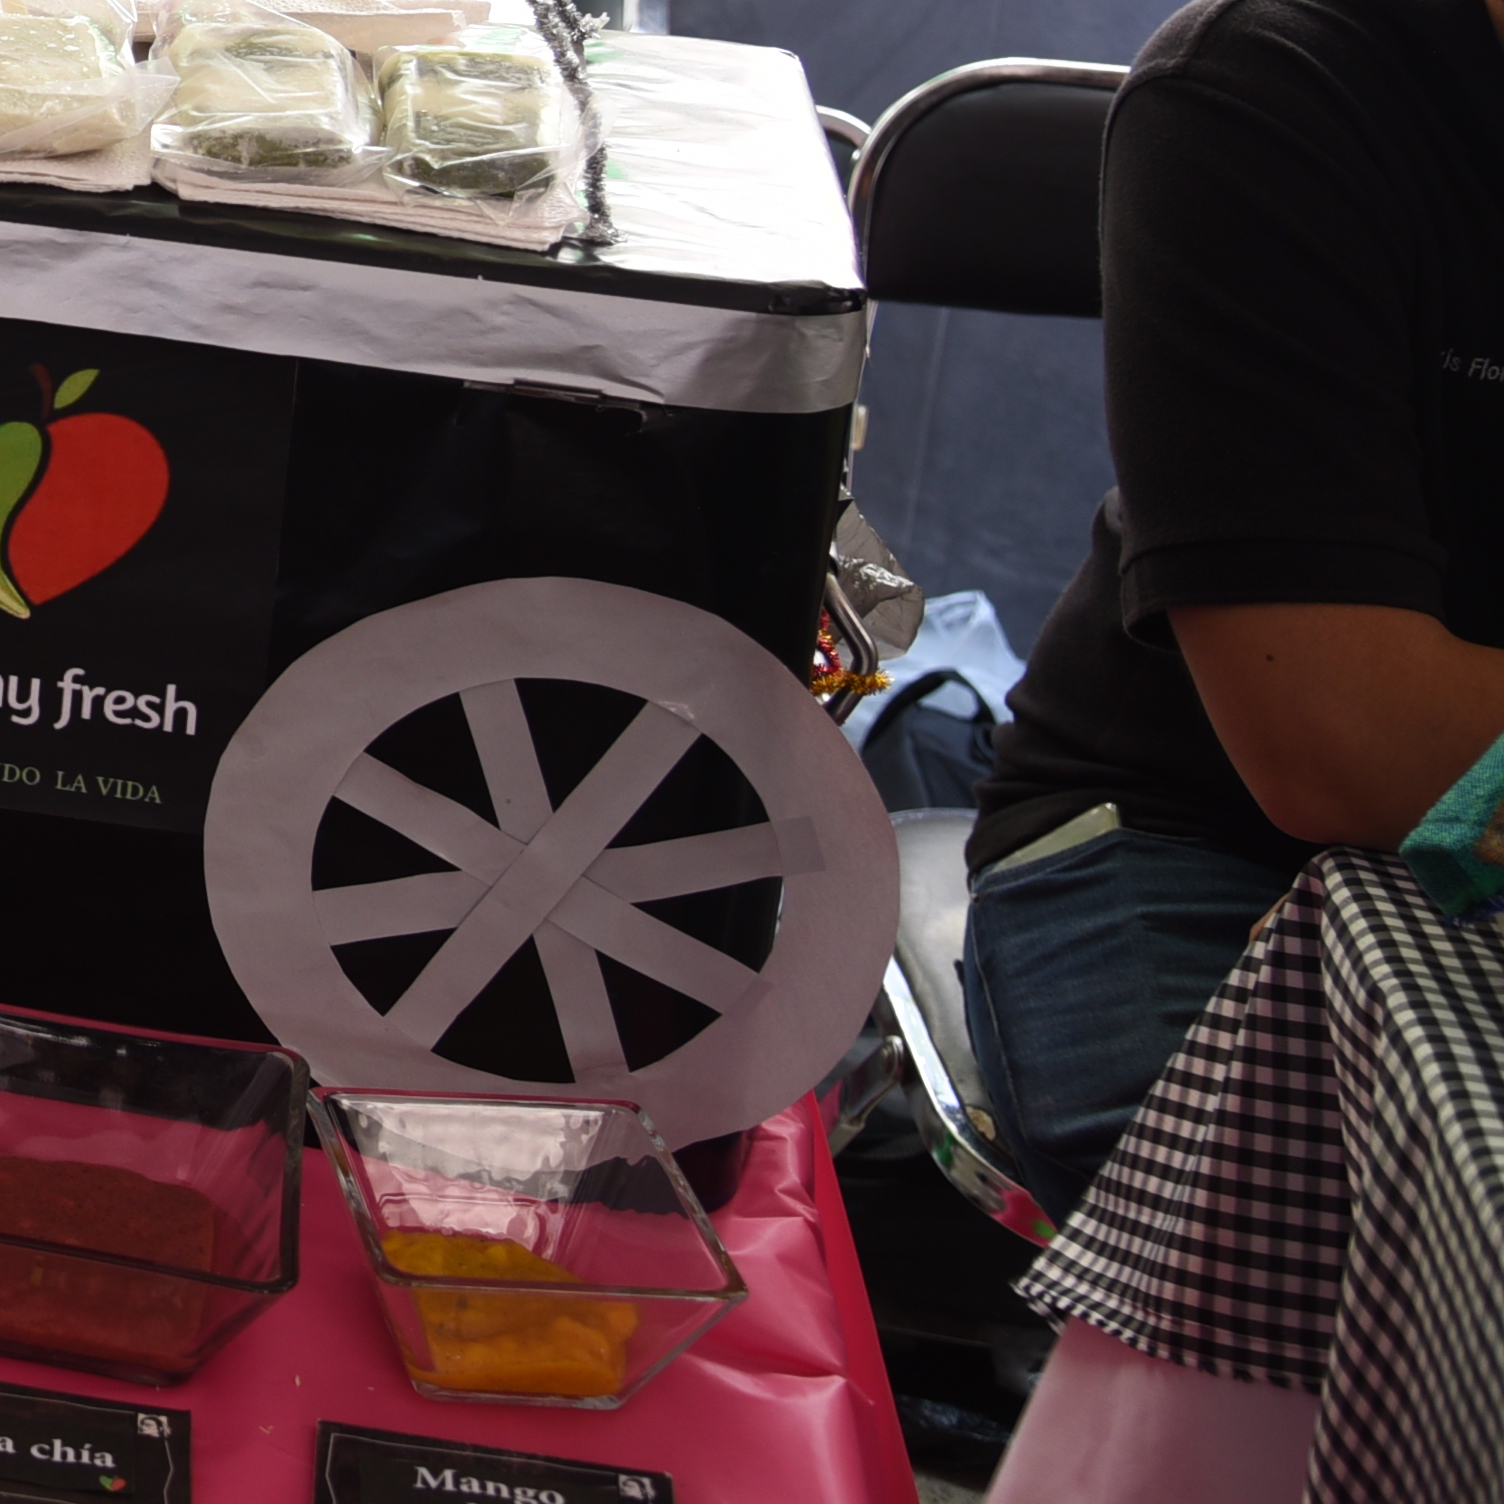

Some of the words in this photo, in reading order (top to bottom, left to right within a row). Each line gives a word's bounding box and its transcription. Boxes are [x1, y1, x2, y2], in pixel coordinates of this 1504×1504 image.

[53, 667, 198, 736] fresh
[55, 770, 88, 794] LA
[96, 775, 163, 805] VIDA
[29, 1438, 117, 1469] chía
[412, 1465, 566, 1504] Mango
